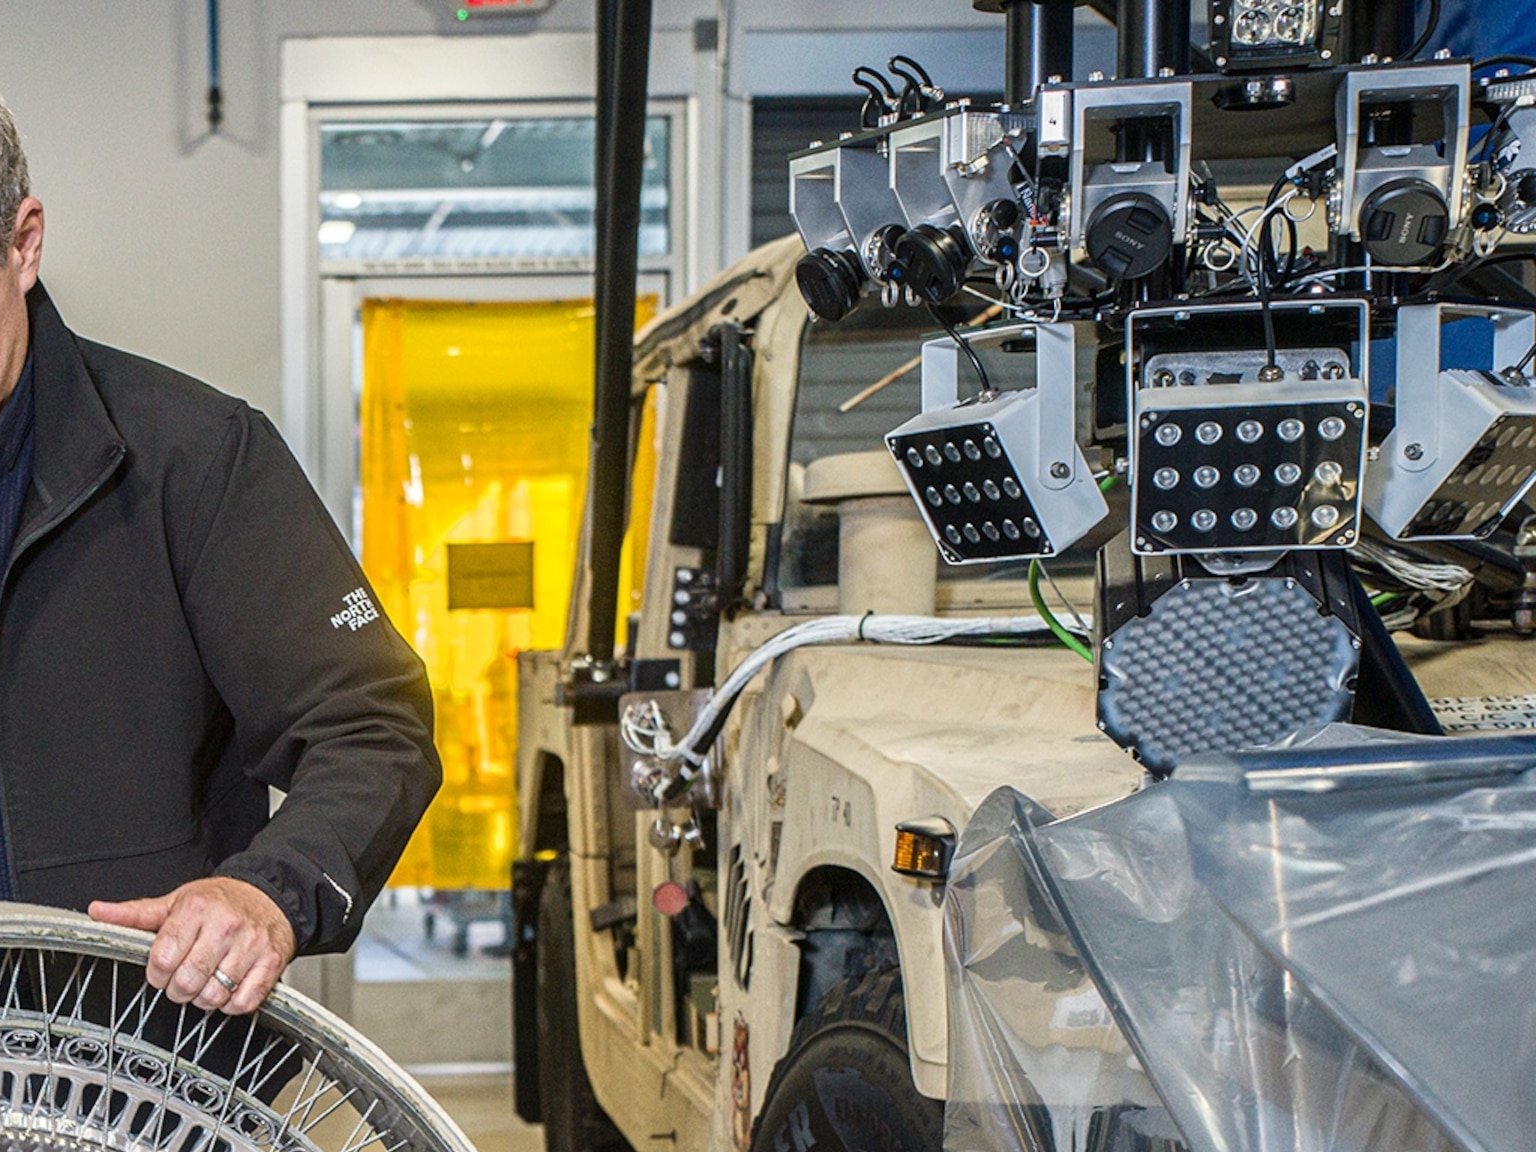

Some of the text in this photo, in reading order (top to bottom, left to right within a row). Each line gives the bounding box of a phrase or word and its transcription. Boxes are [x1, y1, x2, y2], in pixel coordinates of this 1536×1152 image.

[1398, 212, 1415, 244] SONY
[1114, 230, 1145, 250] SONY
[341, 587, 368, 607] THE
[330, 599, 375, 629] NORTH
[348, 608, 380, 631] FACE
